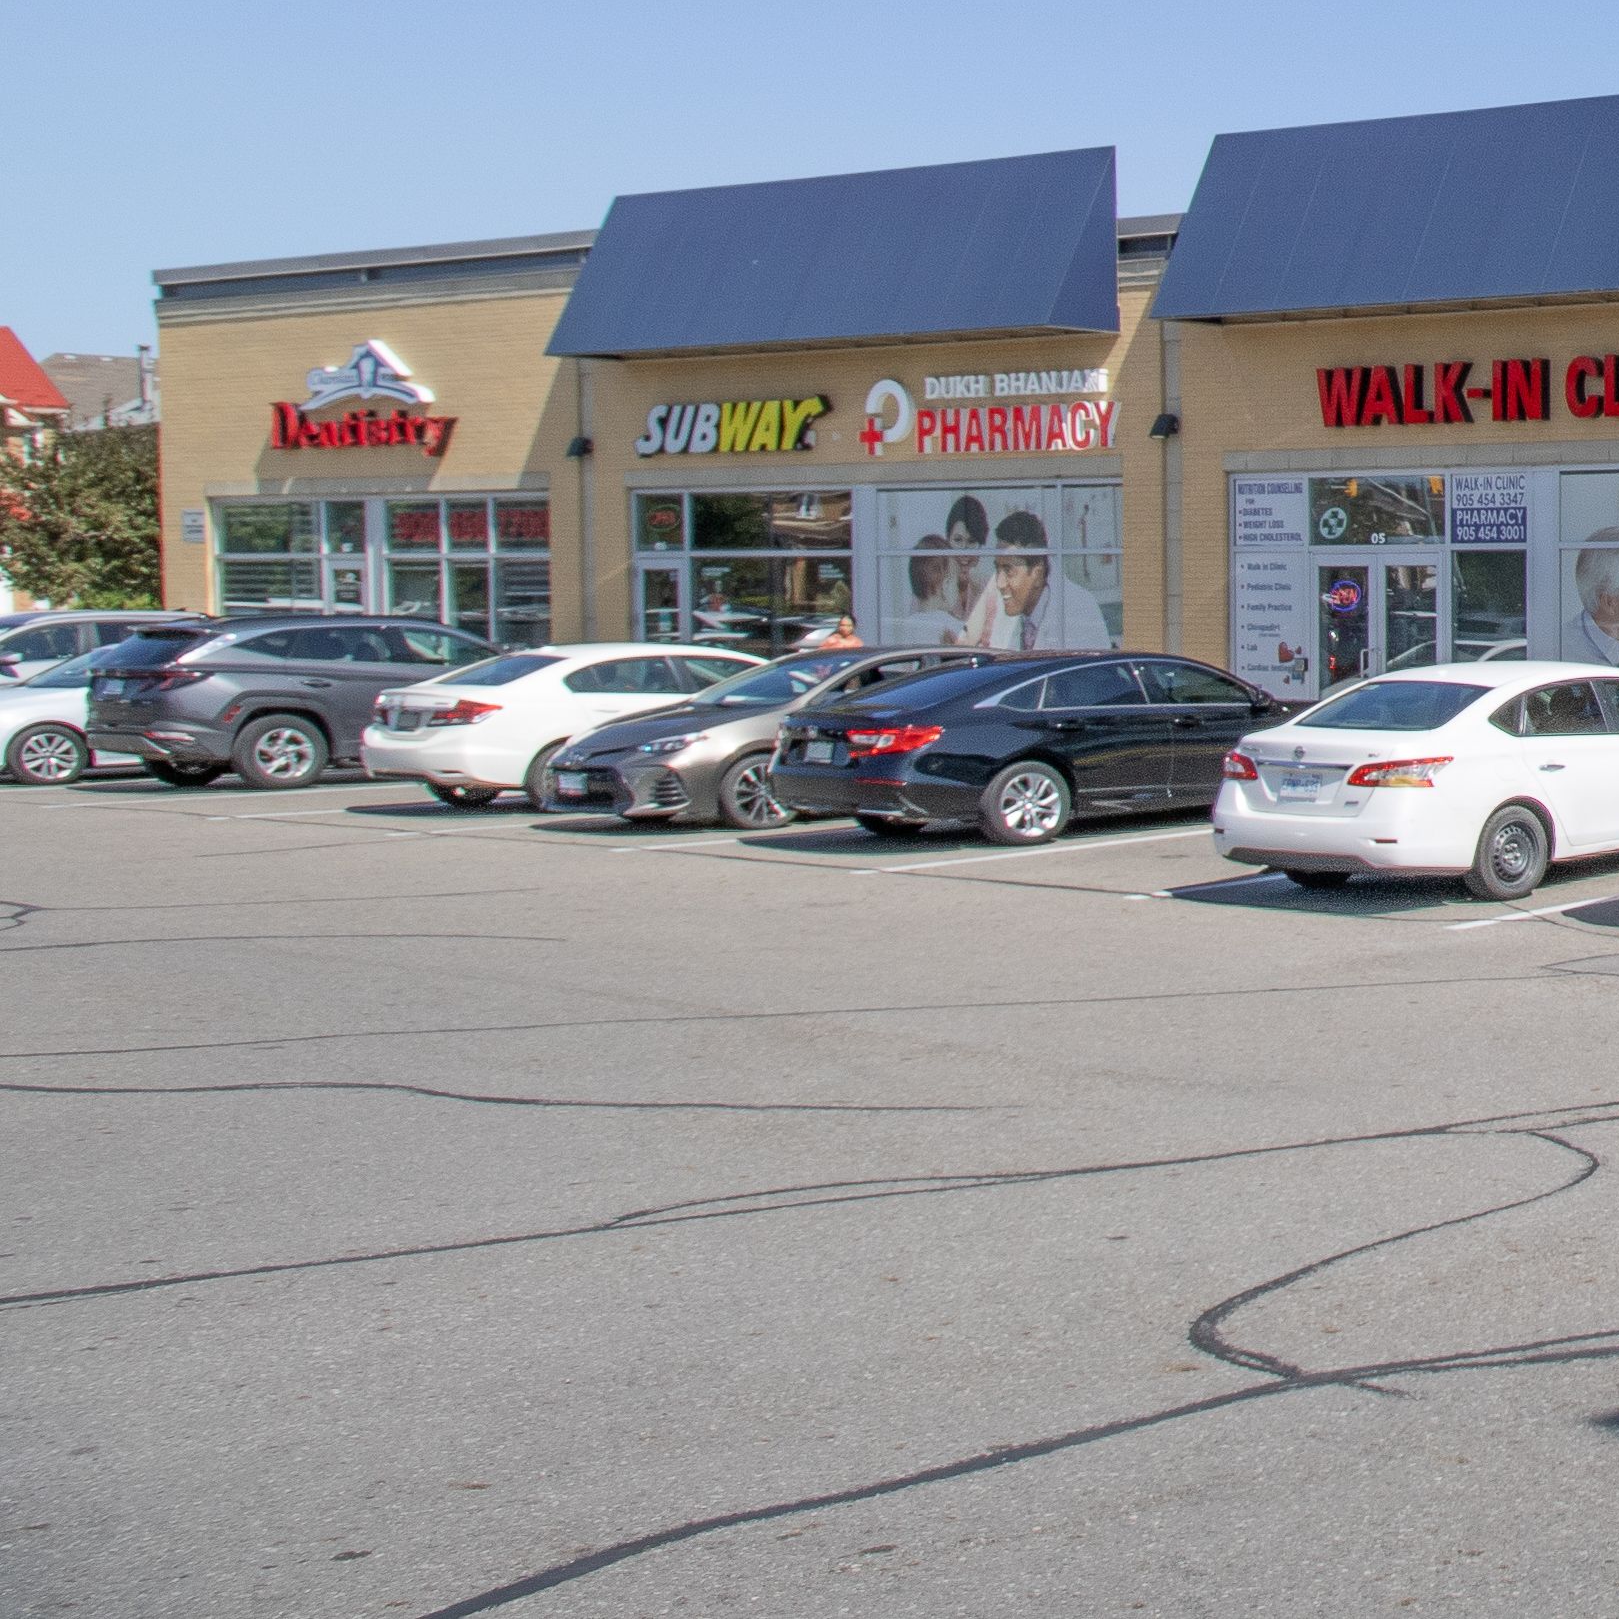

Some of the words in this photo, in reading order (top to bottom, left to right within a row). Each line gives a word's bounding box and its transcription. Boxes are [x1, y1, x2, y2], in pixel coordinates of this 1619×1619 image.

[923, 374, 986, 399] DUKH
[1316, 357, 1550, 428] WALK-IN
[271, 401, 458, 457] Dentistry
[634, 394, 826, 457] SUBWAY
[917, 399, 1117, 453] PHARMACY
[1455, 476, 1493, 491] WALK-IN
[1495, 474, 1526, 490] CLINIC
[1456, 494, 1474, 506] 905
[1477, 493, 1496, 506] 454
[1500, 492, 1525, 506] 3347
[1456, 509, 1524, 524] PHARMACY
[1371, 532, 1386, 544] 05
[1456, 526, 1476, 540] 905
[1478, 526, 1497, 540] 454
[1500, 525, 1525, 539] 3001
